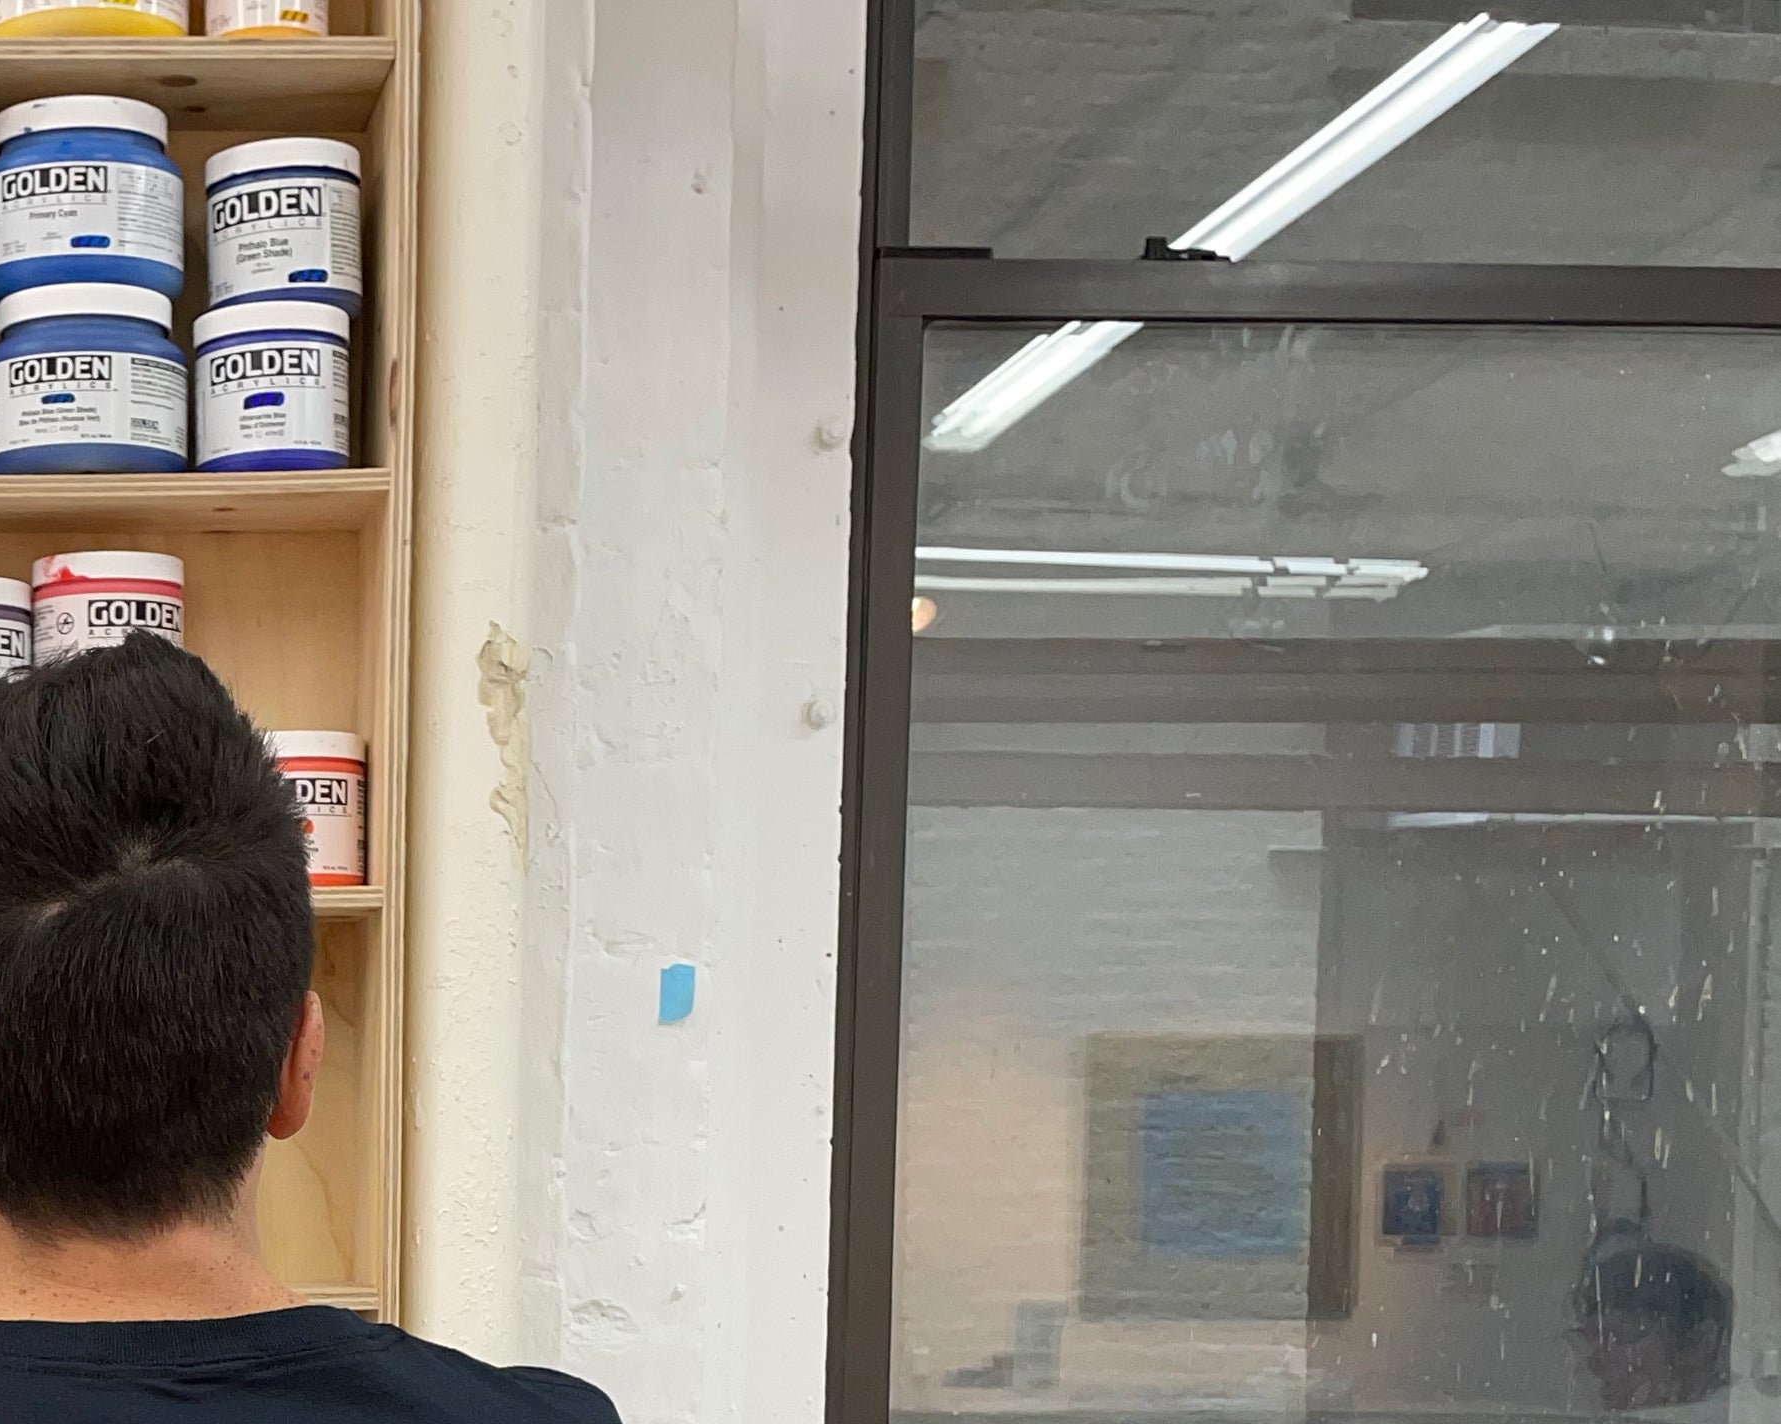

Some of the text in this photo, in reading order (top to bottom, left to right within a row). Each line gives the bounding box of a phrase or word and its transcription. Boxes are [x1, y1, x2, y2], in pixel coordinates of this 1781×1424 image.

[3, 167, 106, 200] GOLDEN
[213, 187, 320, 231] GOLDEN
[10, 356, 110, 385] GOLDEN
[211, 350, 318, 384] GOLDEN
[89, 602, 181, 632] GOLDEN
[295, 780, 347, 804] DEN
